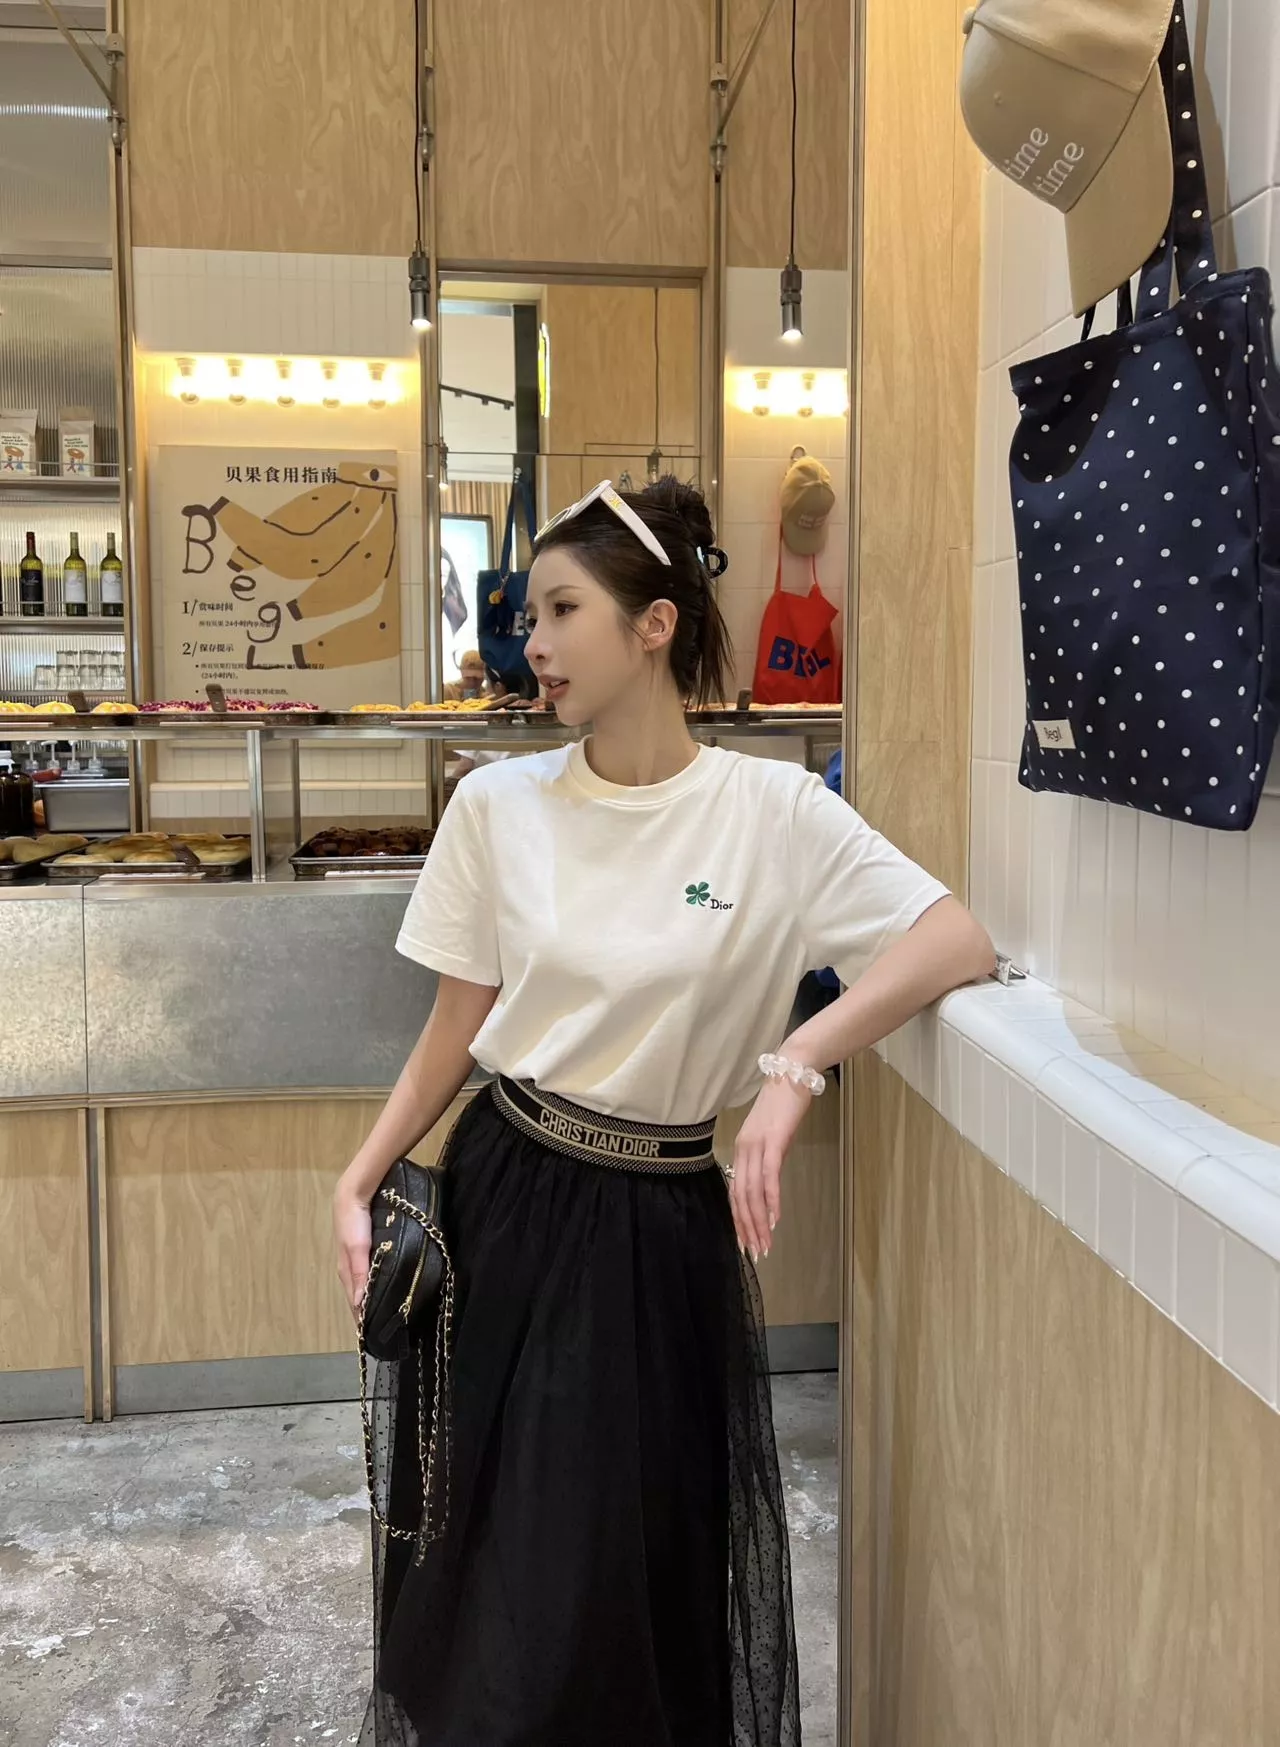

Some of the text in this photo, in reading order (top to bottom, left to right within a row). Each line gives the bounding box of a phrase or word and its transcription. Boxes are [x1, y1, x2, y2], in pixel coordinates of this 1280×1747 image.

[226, 466, 338, 483] 贝果食用指南
[710, 898, 734, 910] Dior
[540, 1108, 660, 1158] CHRISTIAN DIOR
